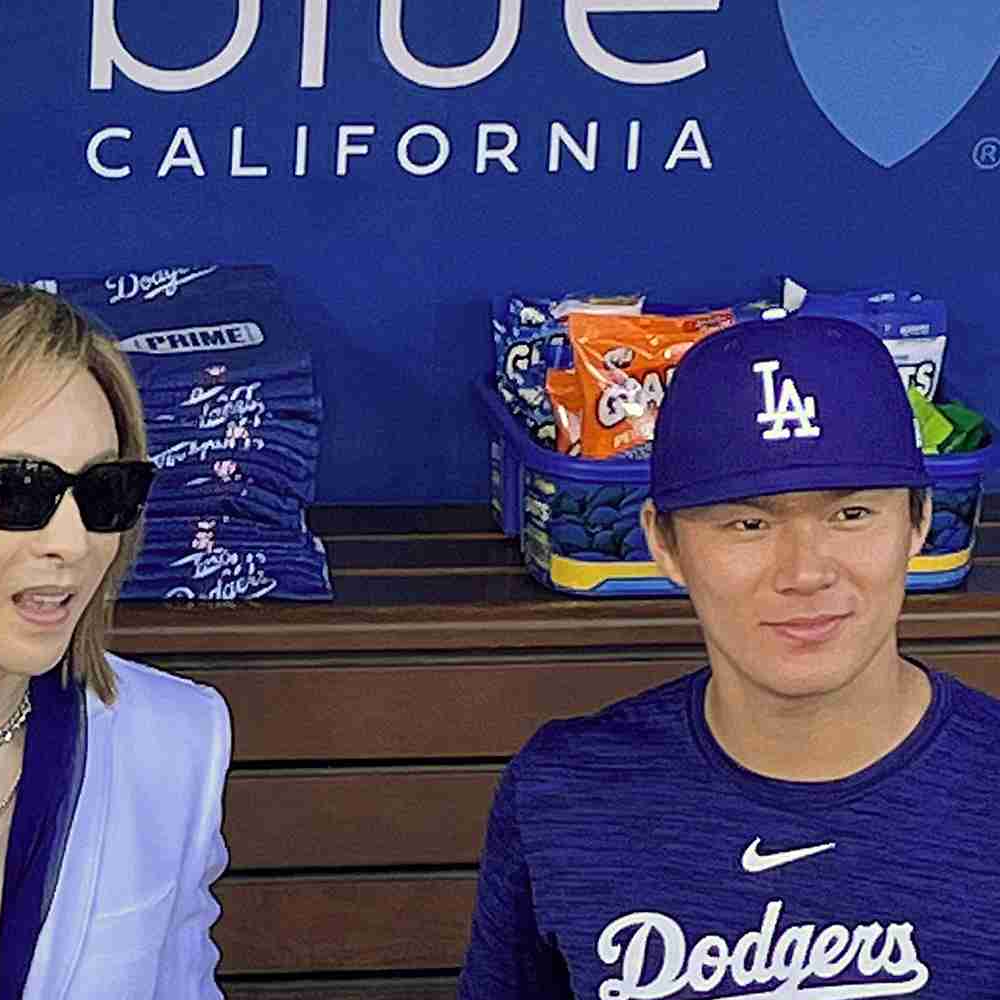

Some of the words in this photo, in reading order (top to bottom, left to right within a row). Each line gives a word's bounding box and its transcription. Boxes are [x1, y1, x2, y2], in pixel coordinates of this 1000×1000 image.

[86, 119, 713, 178] CALIFORNIA
[149, 326, 244, 350] PRIME
[753, 360, 820, 439] LA
